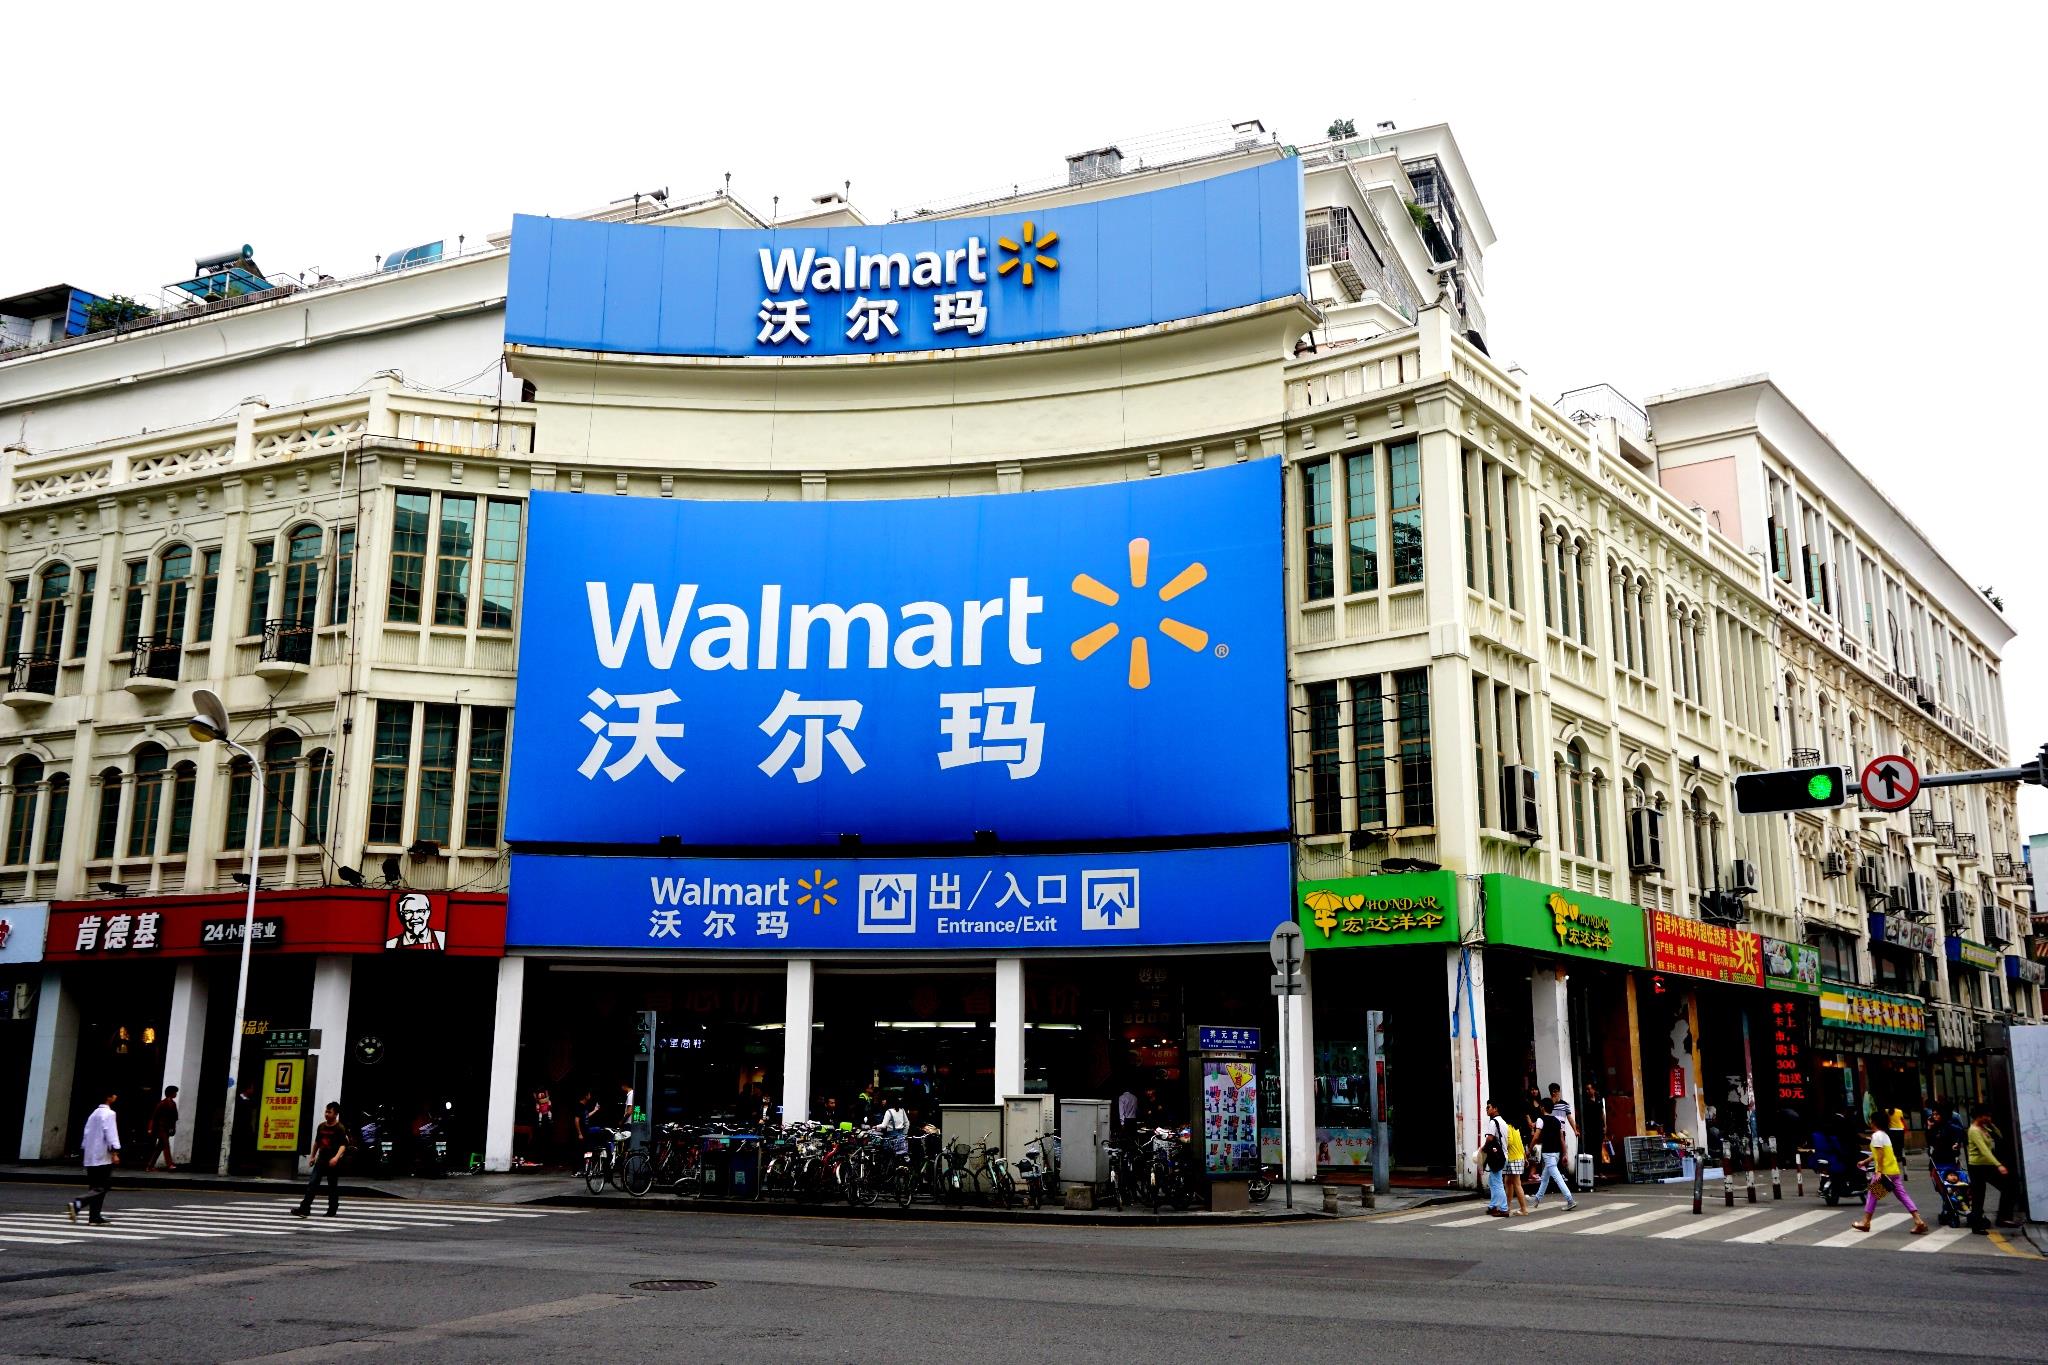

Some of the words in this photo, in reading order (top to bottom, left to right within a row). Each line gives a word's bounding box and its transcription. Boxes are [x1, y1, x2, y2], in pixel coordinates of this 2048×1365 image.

[758, 236, 988, 294] Walmart
[756, 289, 989, 345] 沃尔玛
[585, 576, 1044, 671] Walmart
[577, 685, 1046, 784] 沃尔玛
[650, 876, 790, 906] Walmart
[928, 870, 1067, 911] 出/入口
[1365, 895, 1444, 912] HONDAR
[74, 911, 160, 951] 肯德基
[648, 909, 790, 940] 沃尔玛
[937, 915, 1058, 934] Entrance/Exit
[1340, 912, 1444, 934] 宏达洋伞
[1568, 927, 1614, 951] 宏达洋伞
[279, 1067, 289, 1083] 7
[1776, 1060, 1796, 1069] 300
